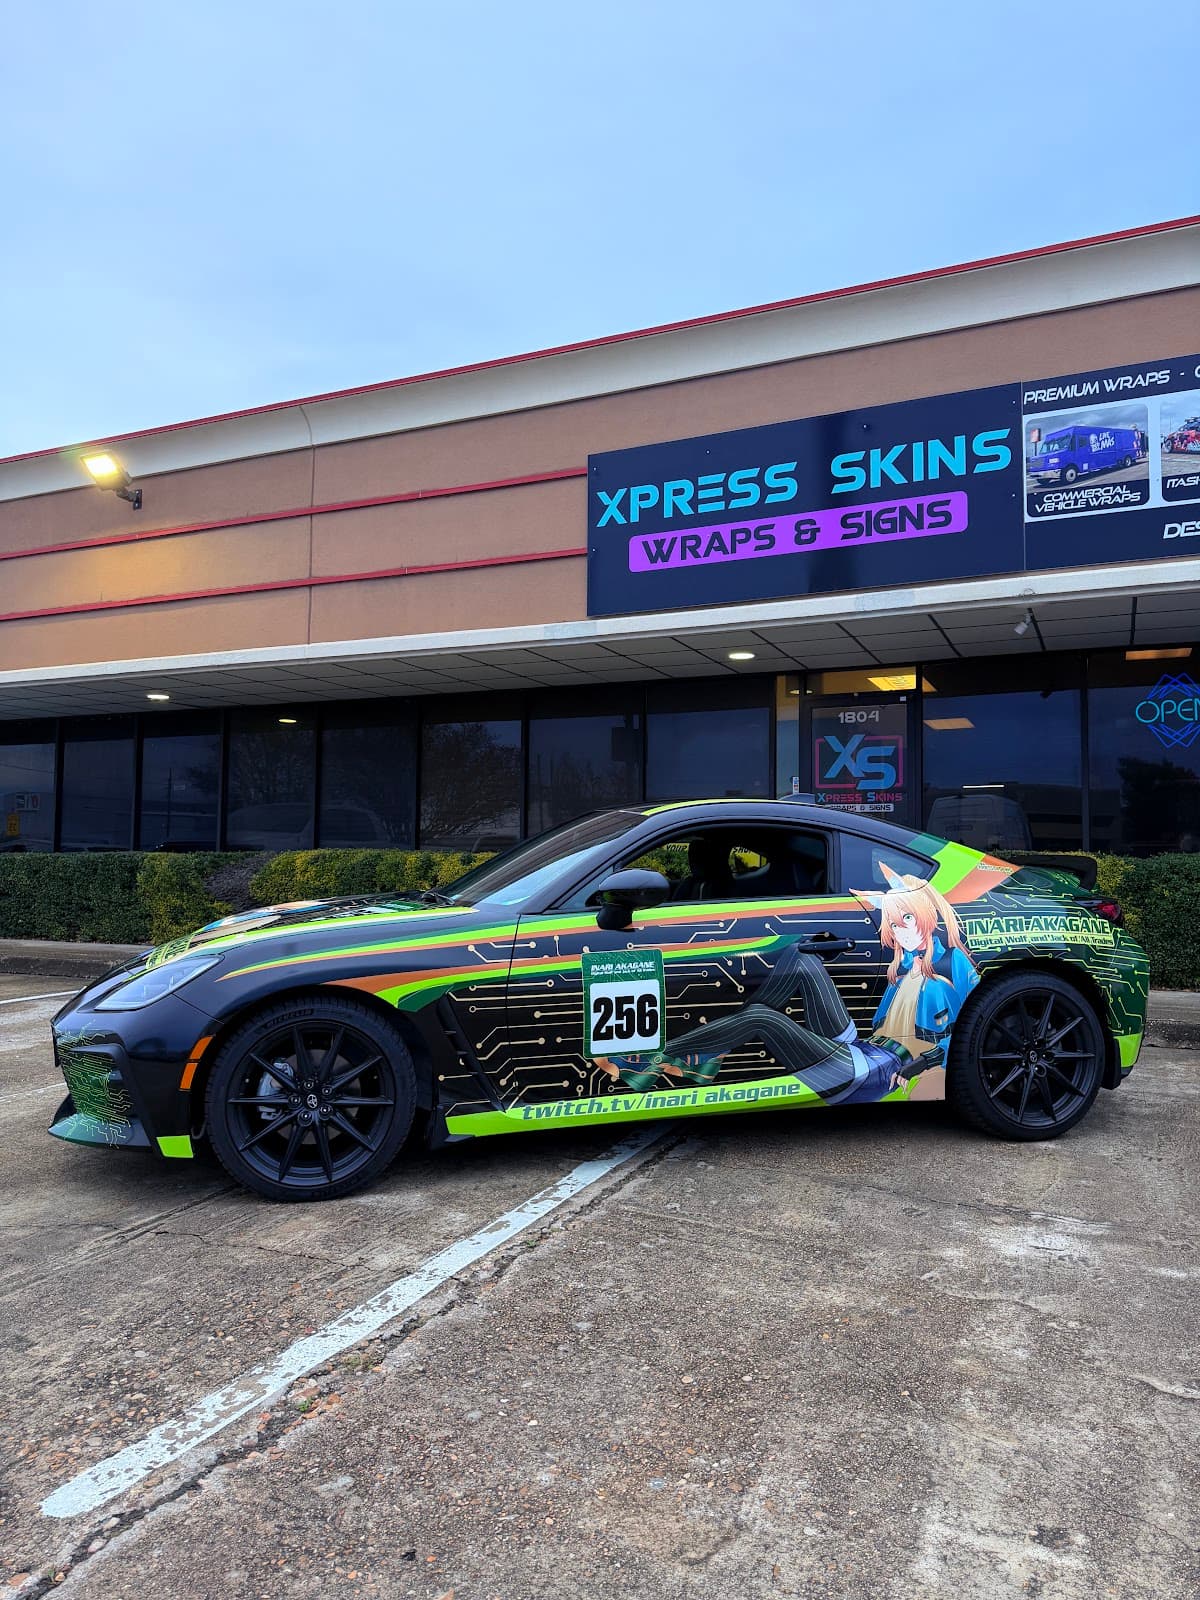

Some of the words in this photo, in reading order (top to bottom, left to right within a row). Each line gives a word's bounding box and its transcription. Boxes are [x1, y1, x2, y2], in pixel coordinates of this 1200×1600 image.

[1023, 380, 1100, 405] PREMIUM
[1103, 370, 1170, 393] WRAPS
[596, 461, 799, 528] XPRESS
[830, 428, 1012, 494] SKINS
[1035, 499, 1087, 513] VEHICLE
[1088, 492, 1141, 507] WRAPS
[1043, 485, 1131, 503] COMMERCIAL
[641, 523, 776, 565] WRAPS
[794, 518, 821, 546] &
[840, 499, 953, 541] SIGNS
[838, 710, 880, 724] 1804
[823, 733, 897, 791] XS
[866, 791, 903, 803] SKINS
[967, 917, 1025, 936] INARI
[1029, 916, 1112, 935] AKAGANE
[969, 936, 1004, 948] Digital
[1005, 935, 1028, 944] Wolf
[1030, 934, 1048, 943] and
[1049, 934, 1067, 943] Jack
[1069, 935, 1078, 943] of
[1091, 935, 1114, 946] Trades
[592, 993, 659, 1042] 256
